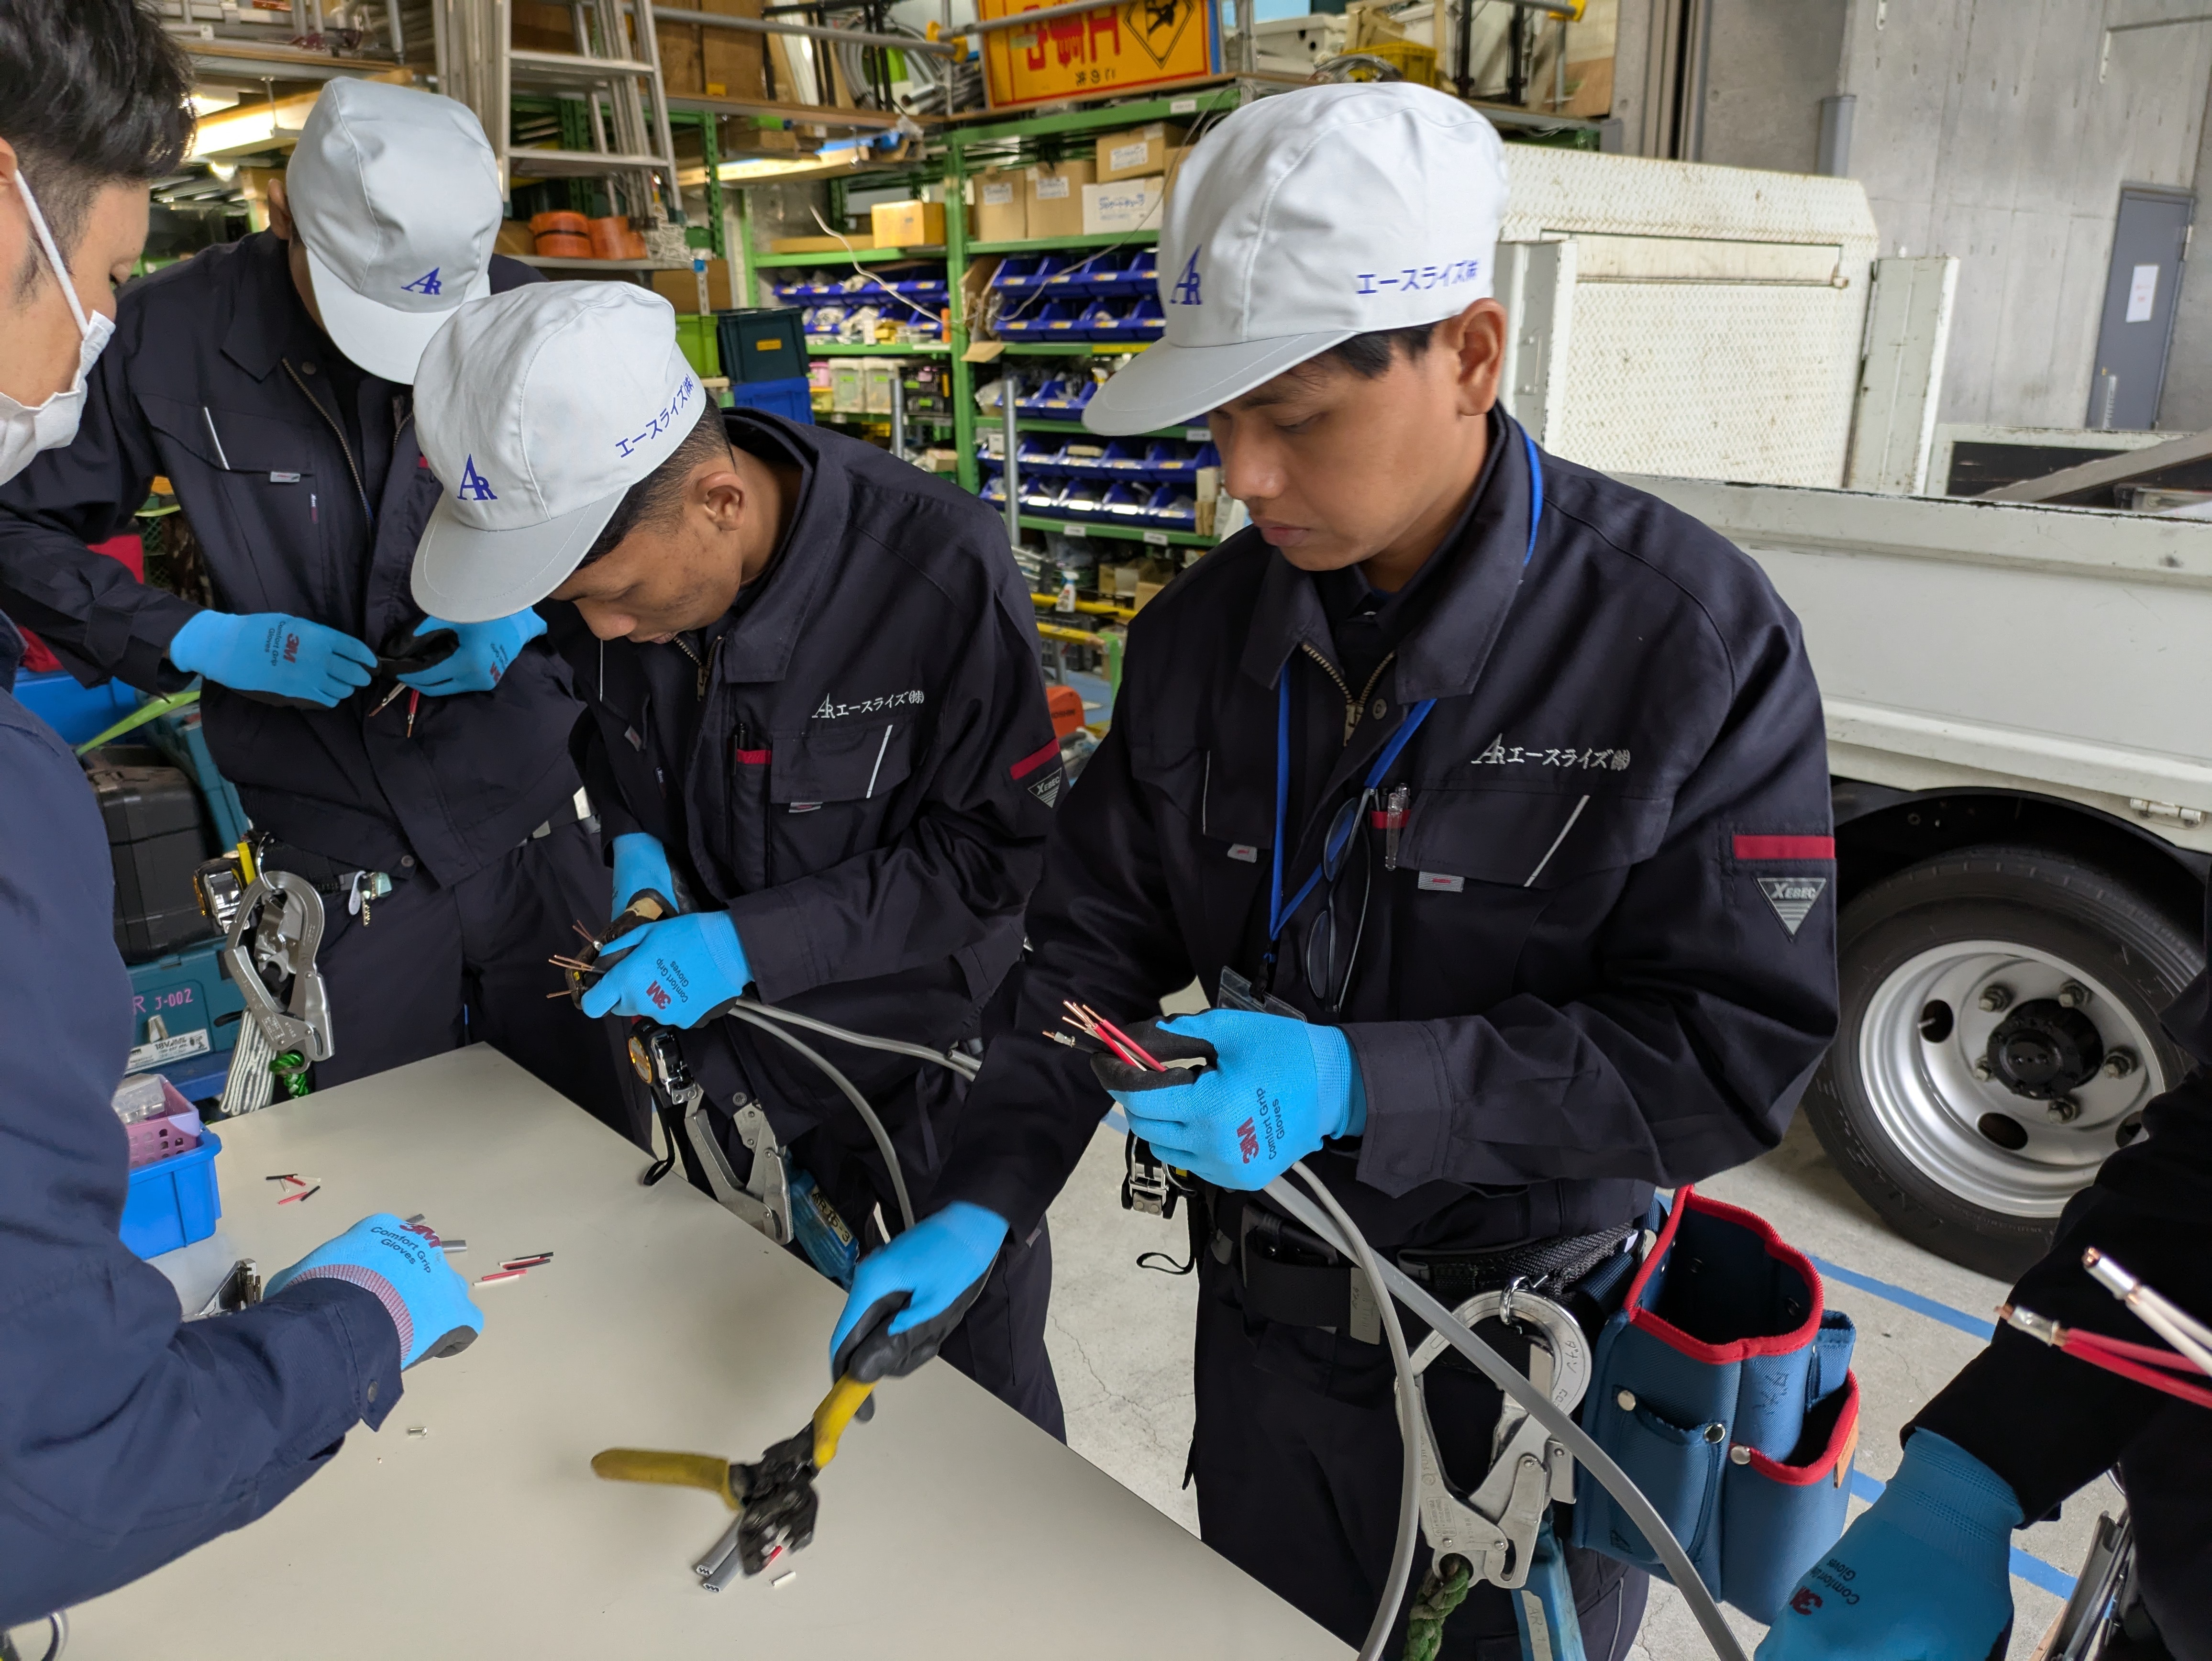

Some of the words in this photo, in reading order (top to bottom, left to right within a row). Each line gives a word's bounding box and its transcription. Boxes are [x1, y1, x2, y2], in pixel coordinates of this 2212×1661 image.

[401, 267, 442, 295] AR
[1170, 244, 1203, 305] AR
[457, 453, 498, 501] AR
[283, 633, 299, 663] 3M
[1037, 776, 1060, 795] XEBEC
[656, 958, 668, 976] Grip
[670, 961, 689, 987] Gloves
[646, 980, 671, 1010] 3M
[666, 974, 688, 1003] Comfort
[1256, 1087, 1269, 1116] Grip
[1272, 1098, 1285, 1140] Gloves
[1237, 1116, 1260, 1164] 3M
[1262, 1116, 1277, 1160] Comfort
[370, 1227, 419, 1251] Comfort
[417, 1250, 431, 1273] Grip
[381, 1239, 416, 1264] Gloves
